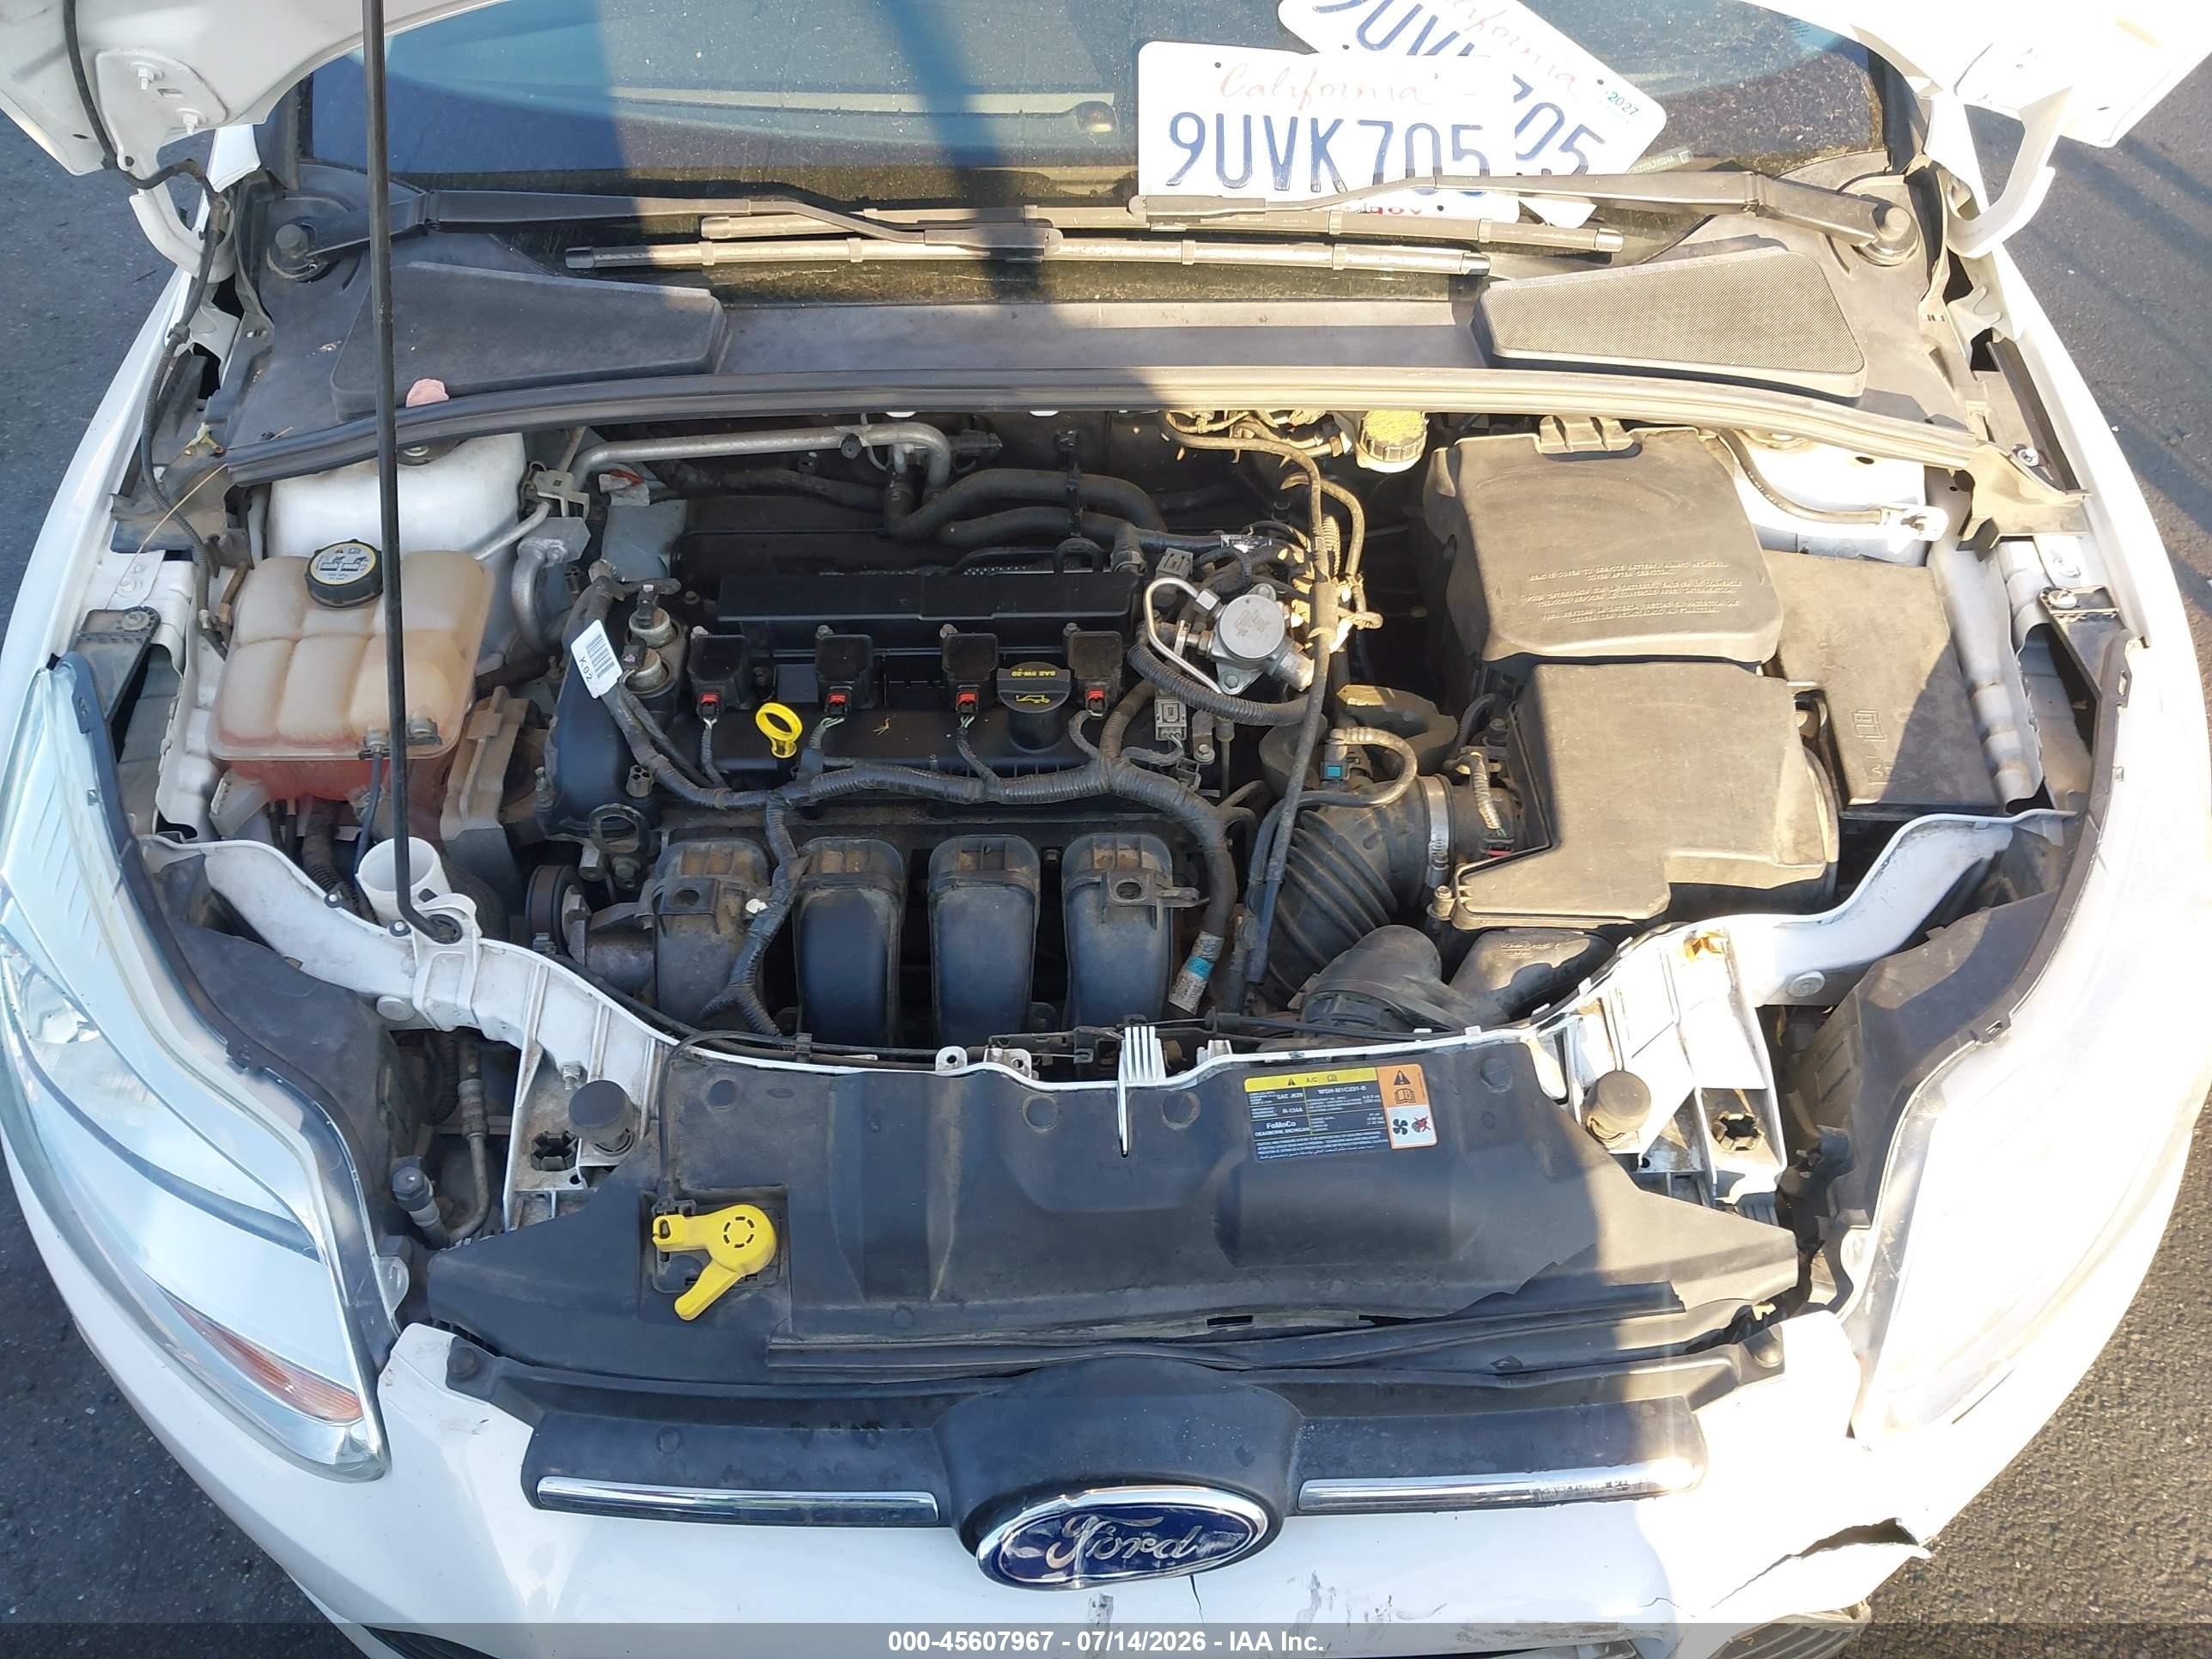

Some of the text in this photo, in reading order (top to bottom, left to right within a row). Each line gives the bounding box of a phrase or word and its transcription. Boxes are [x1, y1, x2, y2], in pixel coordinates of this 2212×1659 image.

[1219, 61, 1435, 111] California
[1607, 91, 1639, 116] 2027
[1164, 111, 1491, 197] 9UVK705
[579, 656, 593, 683] K02
[1266, 1121, 1297, 1130] FoMoCo
[1045, 1515, 1201, 1571] Ford
